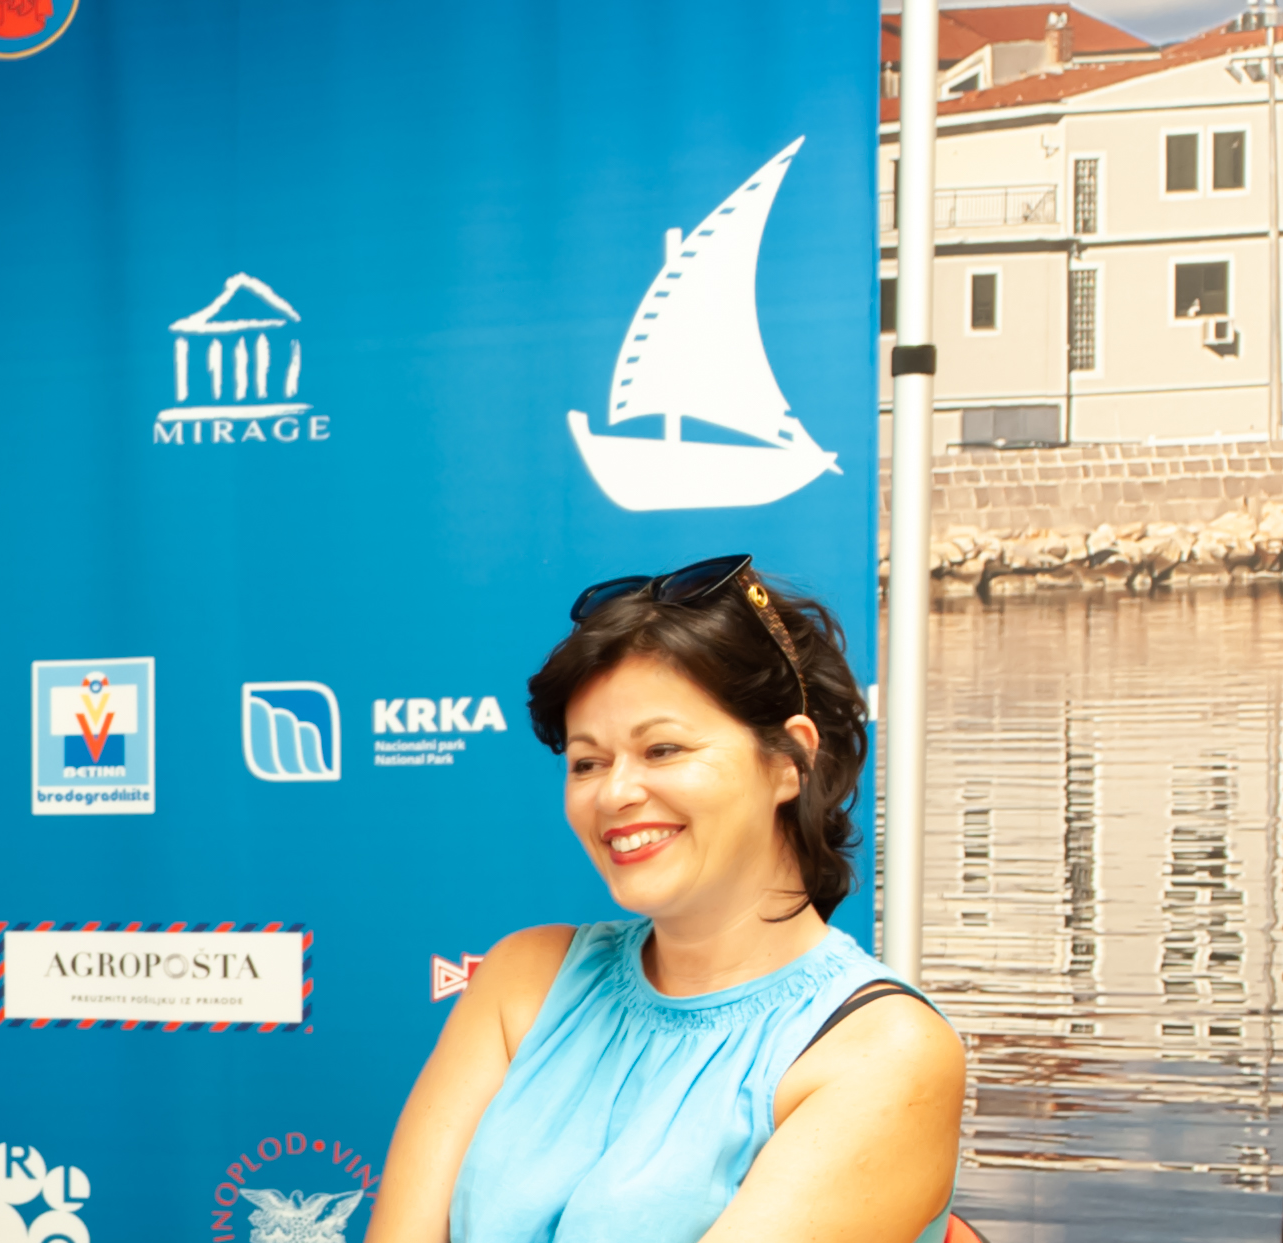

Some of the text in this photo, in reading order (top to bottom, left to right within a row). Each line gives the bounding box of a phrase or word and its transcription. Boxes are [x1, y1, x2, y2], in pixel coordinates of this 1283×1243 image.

[153, 415, 332, 445] MIRAGE
[373, 696, 509, 734] KRKA
[374, 738, 466, 753] Nacionalni park
[374, 752, 455, 766] National Park
[63, 765, 126, 779] BETINA
[44, 949, 262, 980] AGROPOŠTA
[71, 995, 127, 1003] PREUZMITE
[180, 997, 191, 1005] IZ
[196, 997, 244, 1005] PRIRODE
